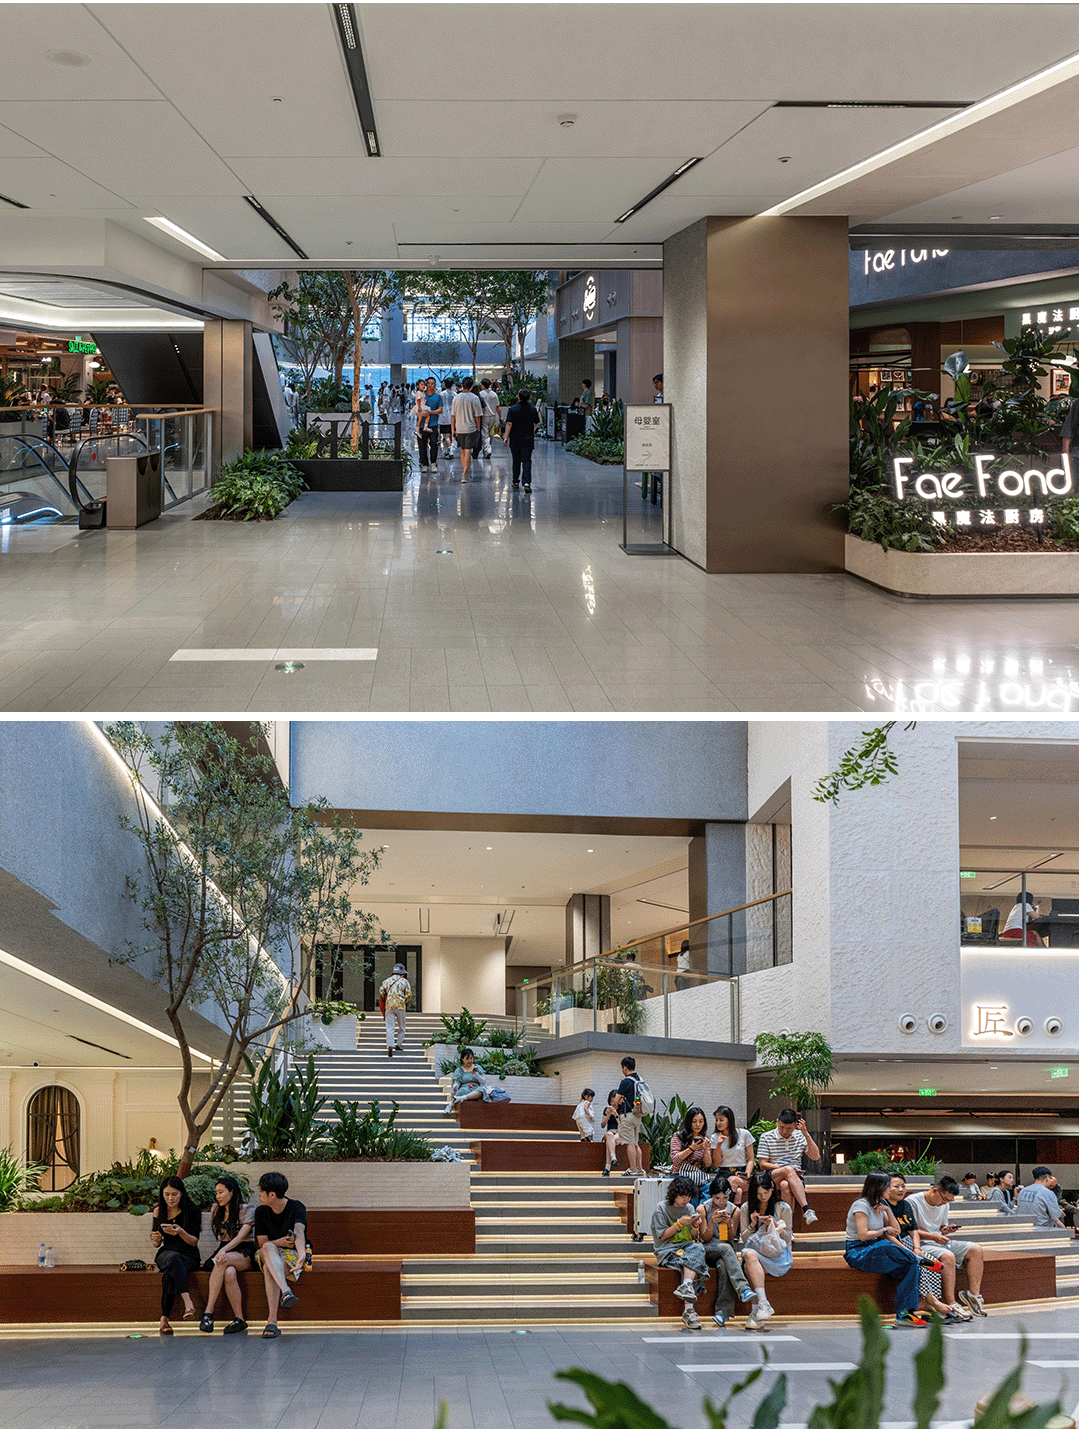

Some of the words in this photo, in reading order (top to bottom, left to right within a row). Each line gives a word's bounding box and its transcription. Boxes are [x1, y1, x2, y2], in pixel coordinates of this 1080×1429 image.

[634, 416, 660, 426] 母婴室
[893, 457, 965, 500] Fae
[974, 452, 1073, 498] Fond
[973, 1004, 1014, 1037] 匠
